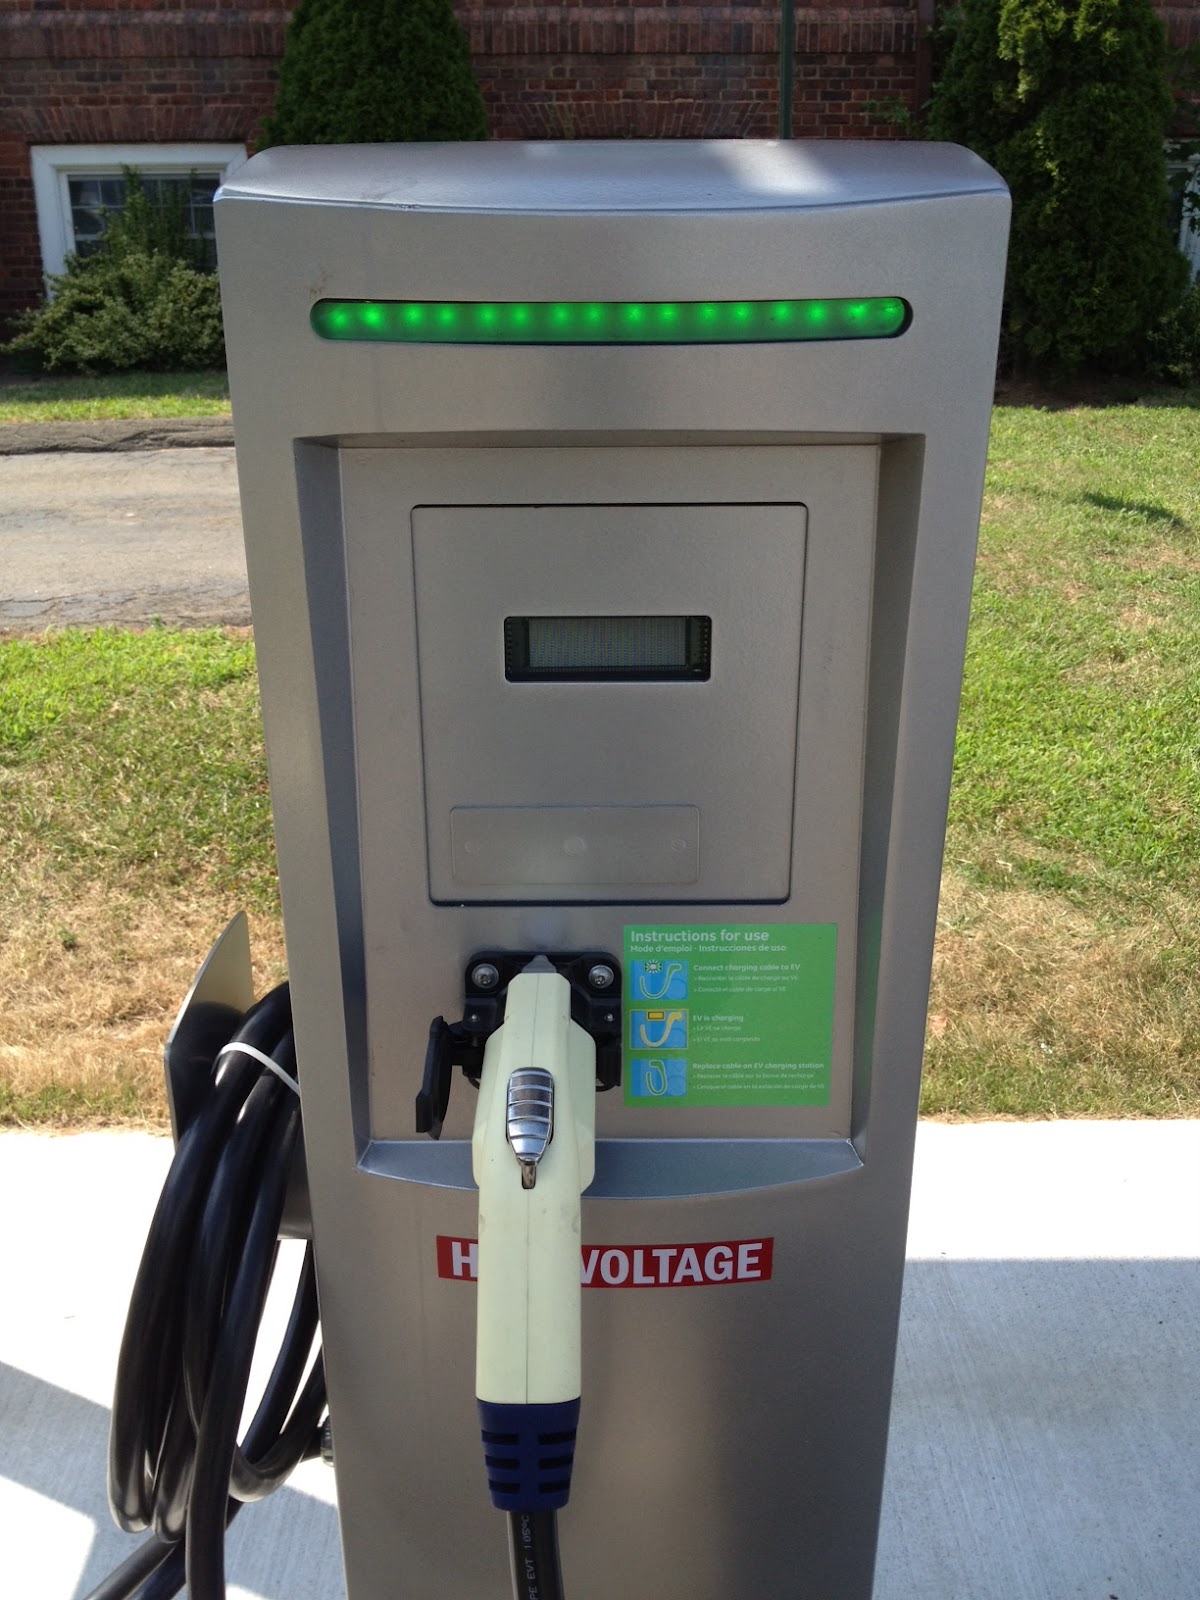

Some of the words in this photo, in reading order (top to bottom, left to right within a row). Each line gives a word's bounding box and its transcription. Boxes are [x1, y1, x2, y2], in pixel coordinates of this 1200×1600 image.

[630, 930, 717, 942] Instructions
[719, 929, 741, 941] for
[744, 931, 770, 941] use
[655, 945, 692, 954] d'emploi
[699, 944, 756, 952] Instrucciones
[758, 944, 769, 952] de
[725, 964, 758, 972] charging
[711, 1015, 744, 1023] charging
[581, 1242, 763, 1284] VOLTAGE
